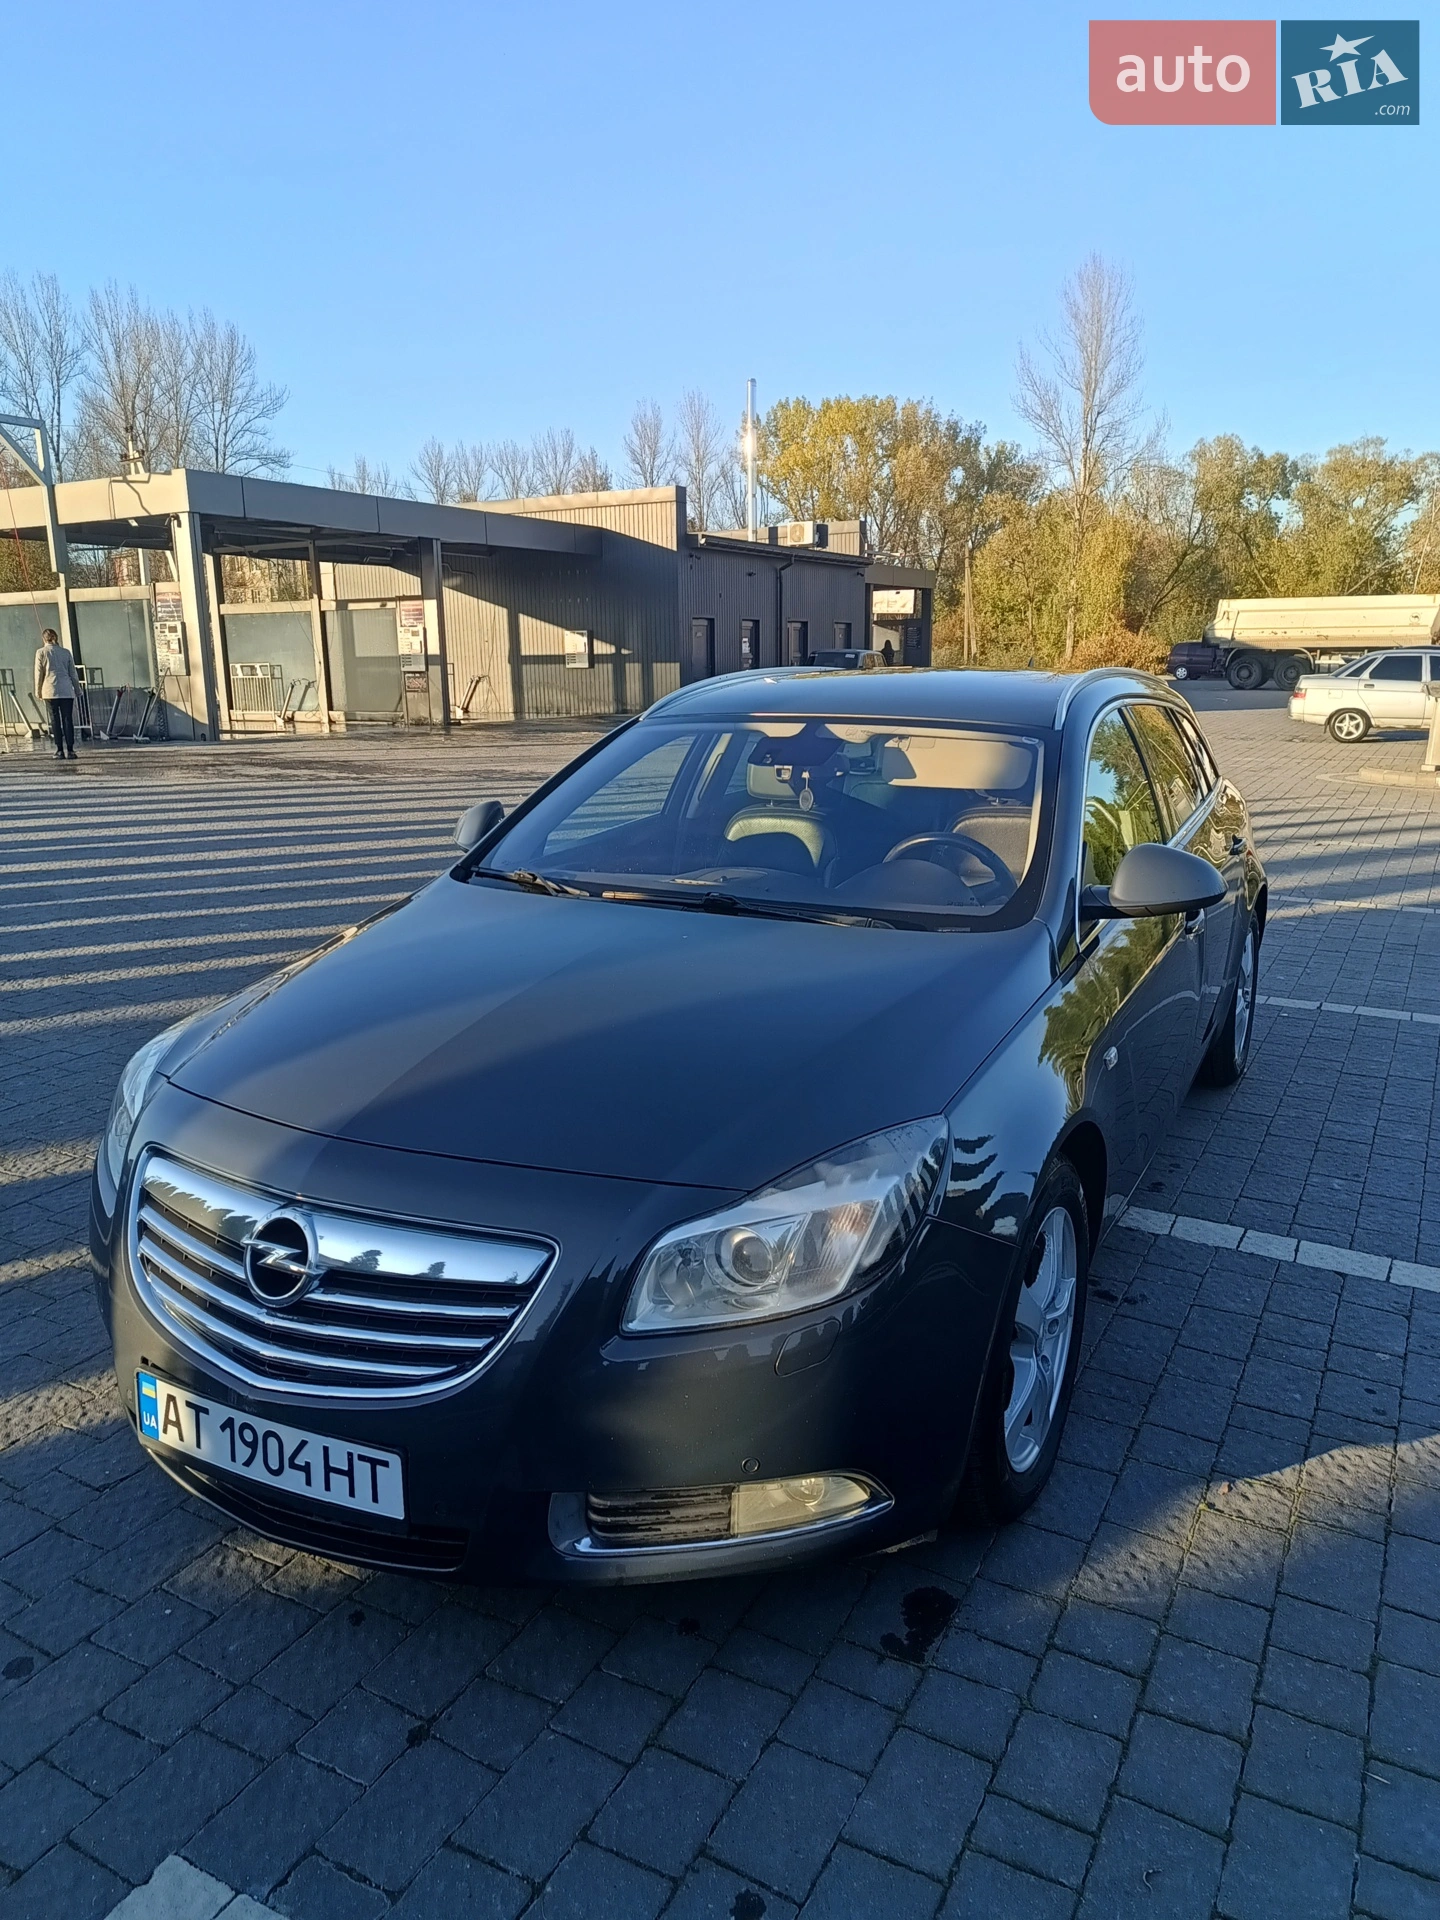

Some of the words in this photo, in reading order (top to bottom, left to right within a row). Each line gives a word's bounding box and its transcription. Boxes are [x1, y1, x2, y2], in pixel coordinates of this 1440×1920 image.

[143, 1411, 158, 1430] UA
[162, 1393, 210, 1450] AT
[219, 1416, 312, 1488] 1904
[322, 1445, 390, 1504] HT
